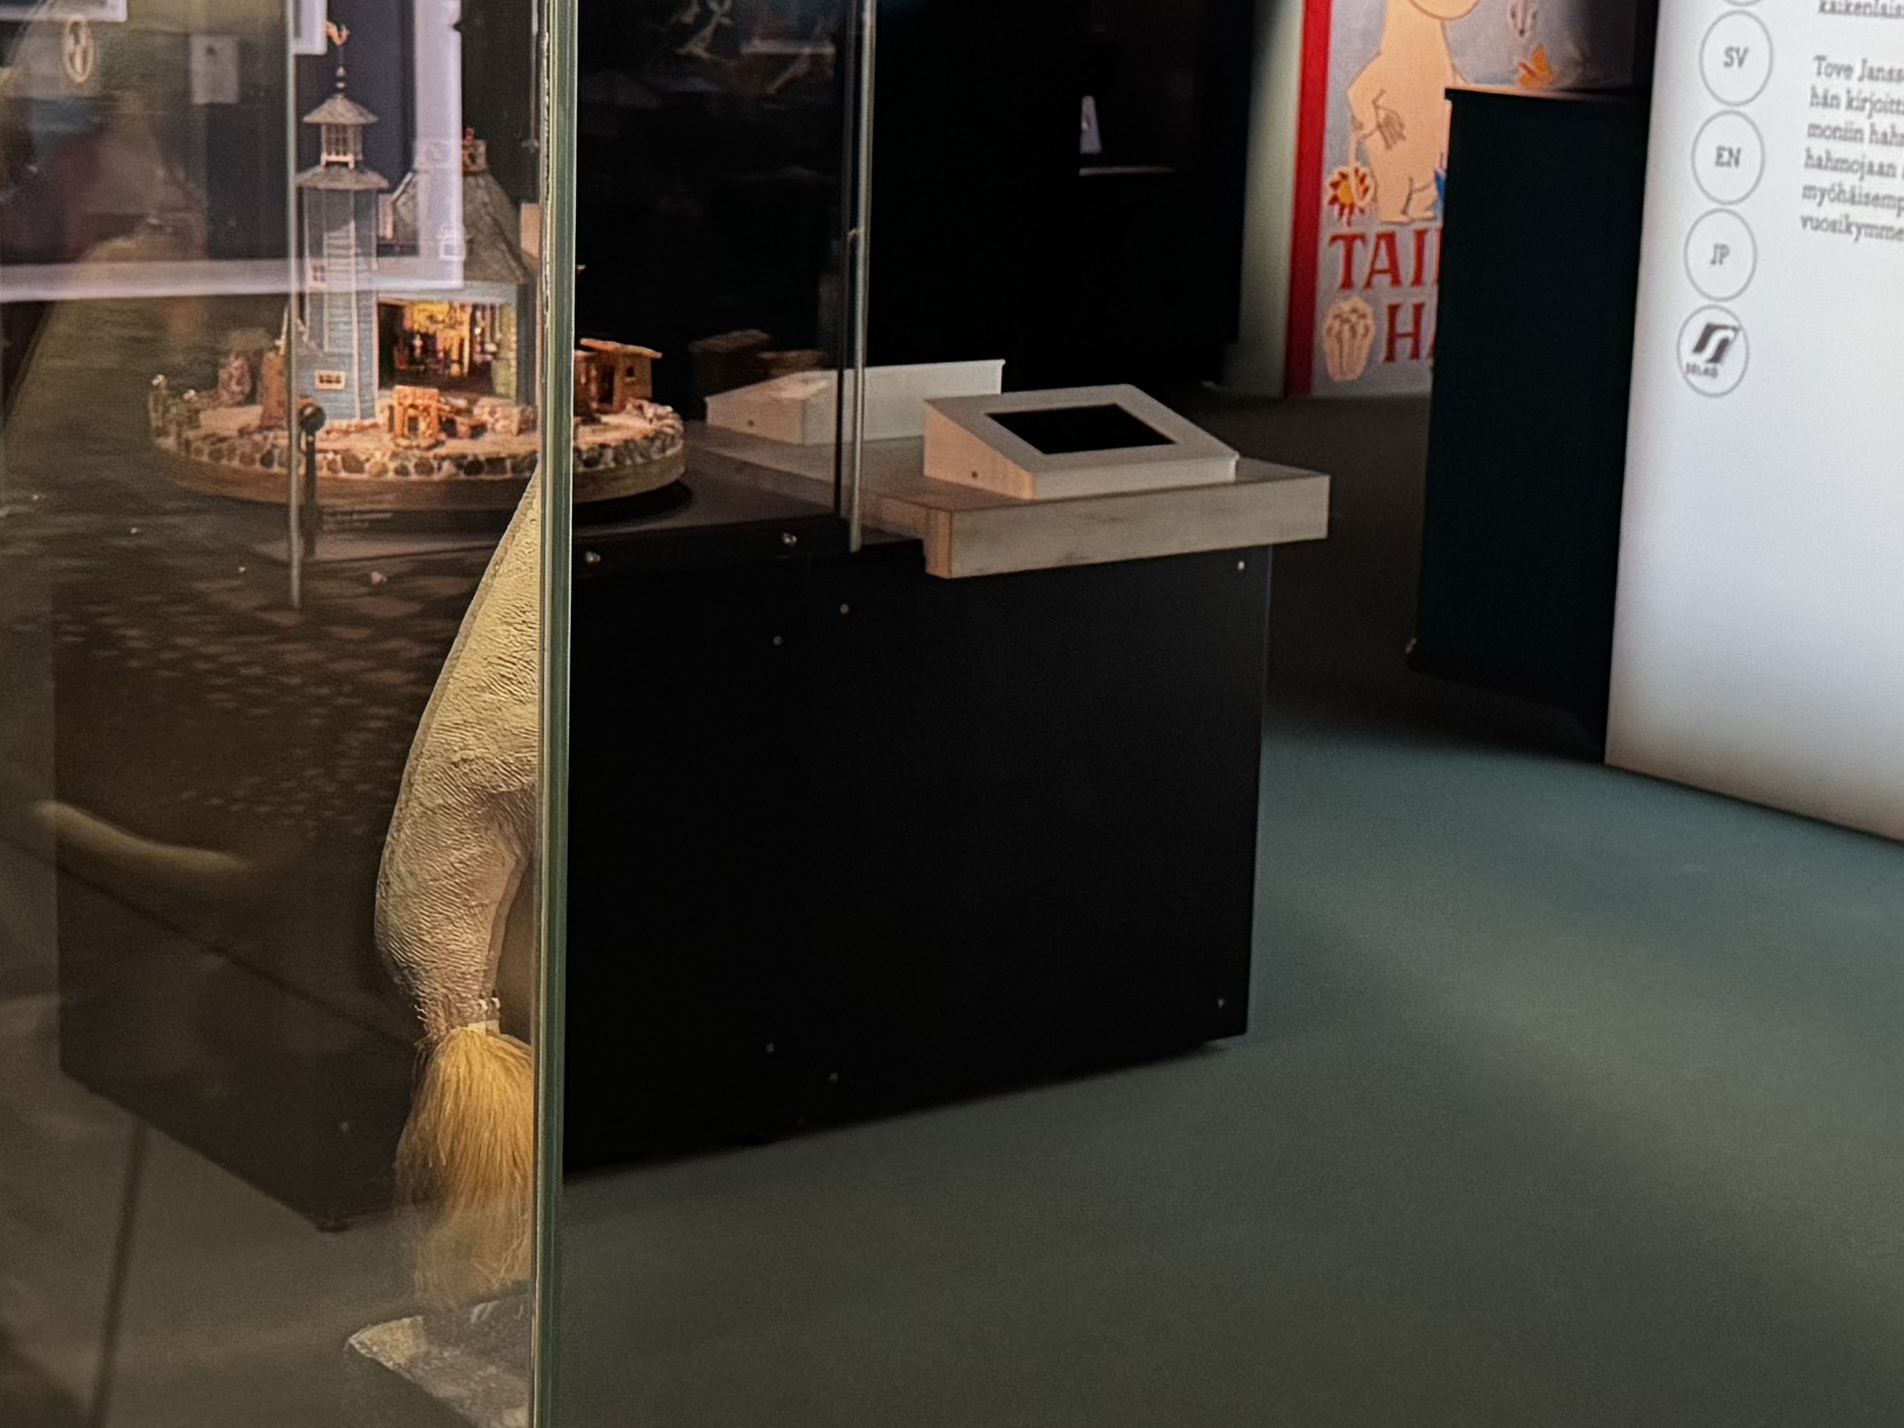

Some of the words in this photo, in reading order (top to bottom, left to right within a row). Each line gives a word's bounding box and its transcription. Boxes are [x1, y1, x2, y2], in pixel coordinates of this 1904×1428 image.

[1723, 46, 1748, 68] SV
[1813, 55, 1854, 79] Tove
[1810, 86, 1841, 110] hän
[1807, 120, 1864, 144] moniin
[1715, 147, 1741, 169] EN
[1804, 148, 1896, 182] hahmojaan
[1328, 228, 1441, 291] TAI
[1710, 244, 1730, 266] JP
[1384, 302, 1435, 363] H
